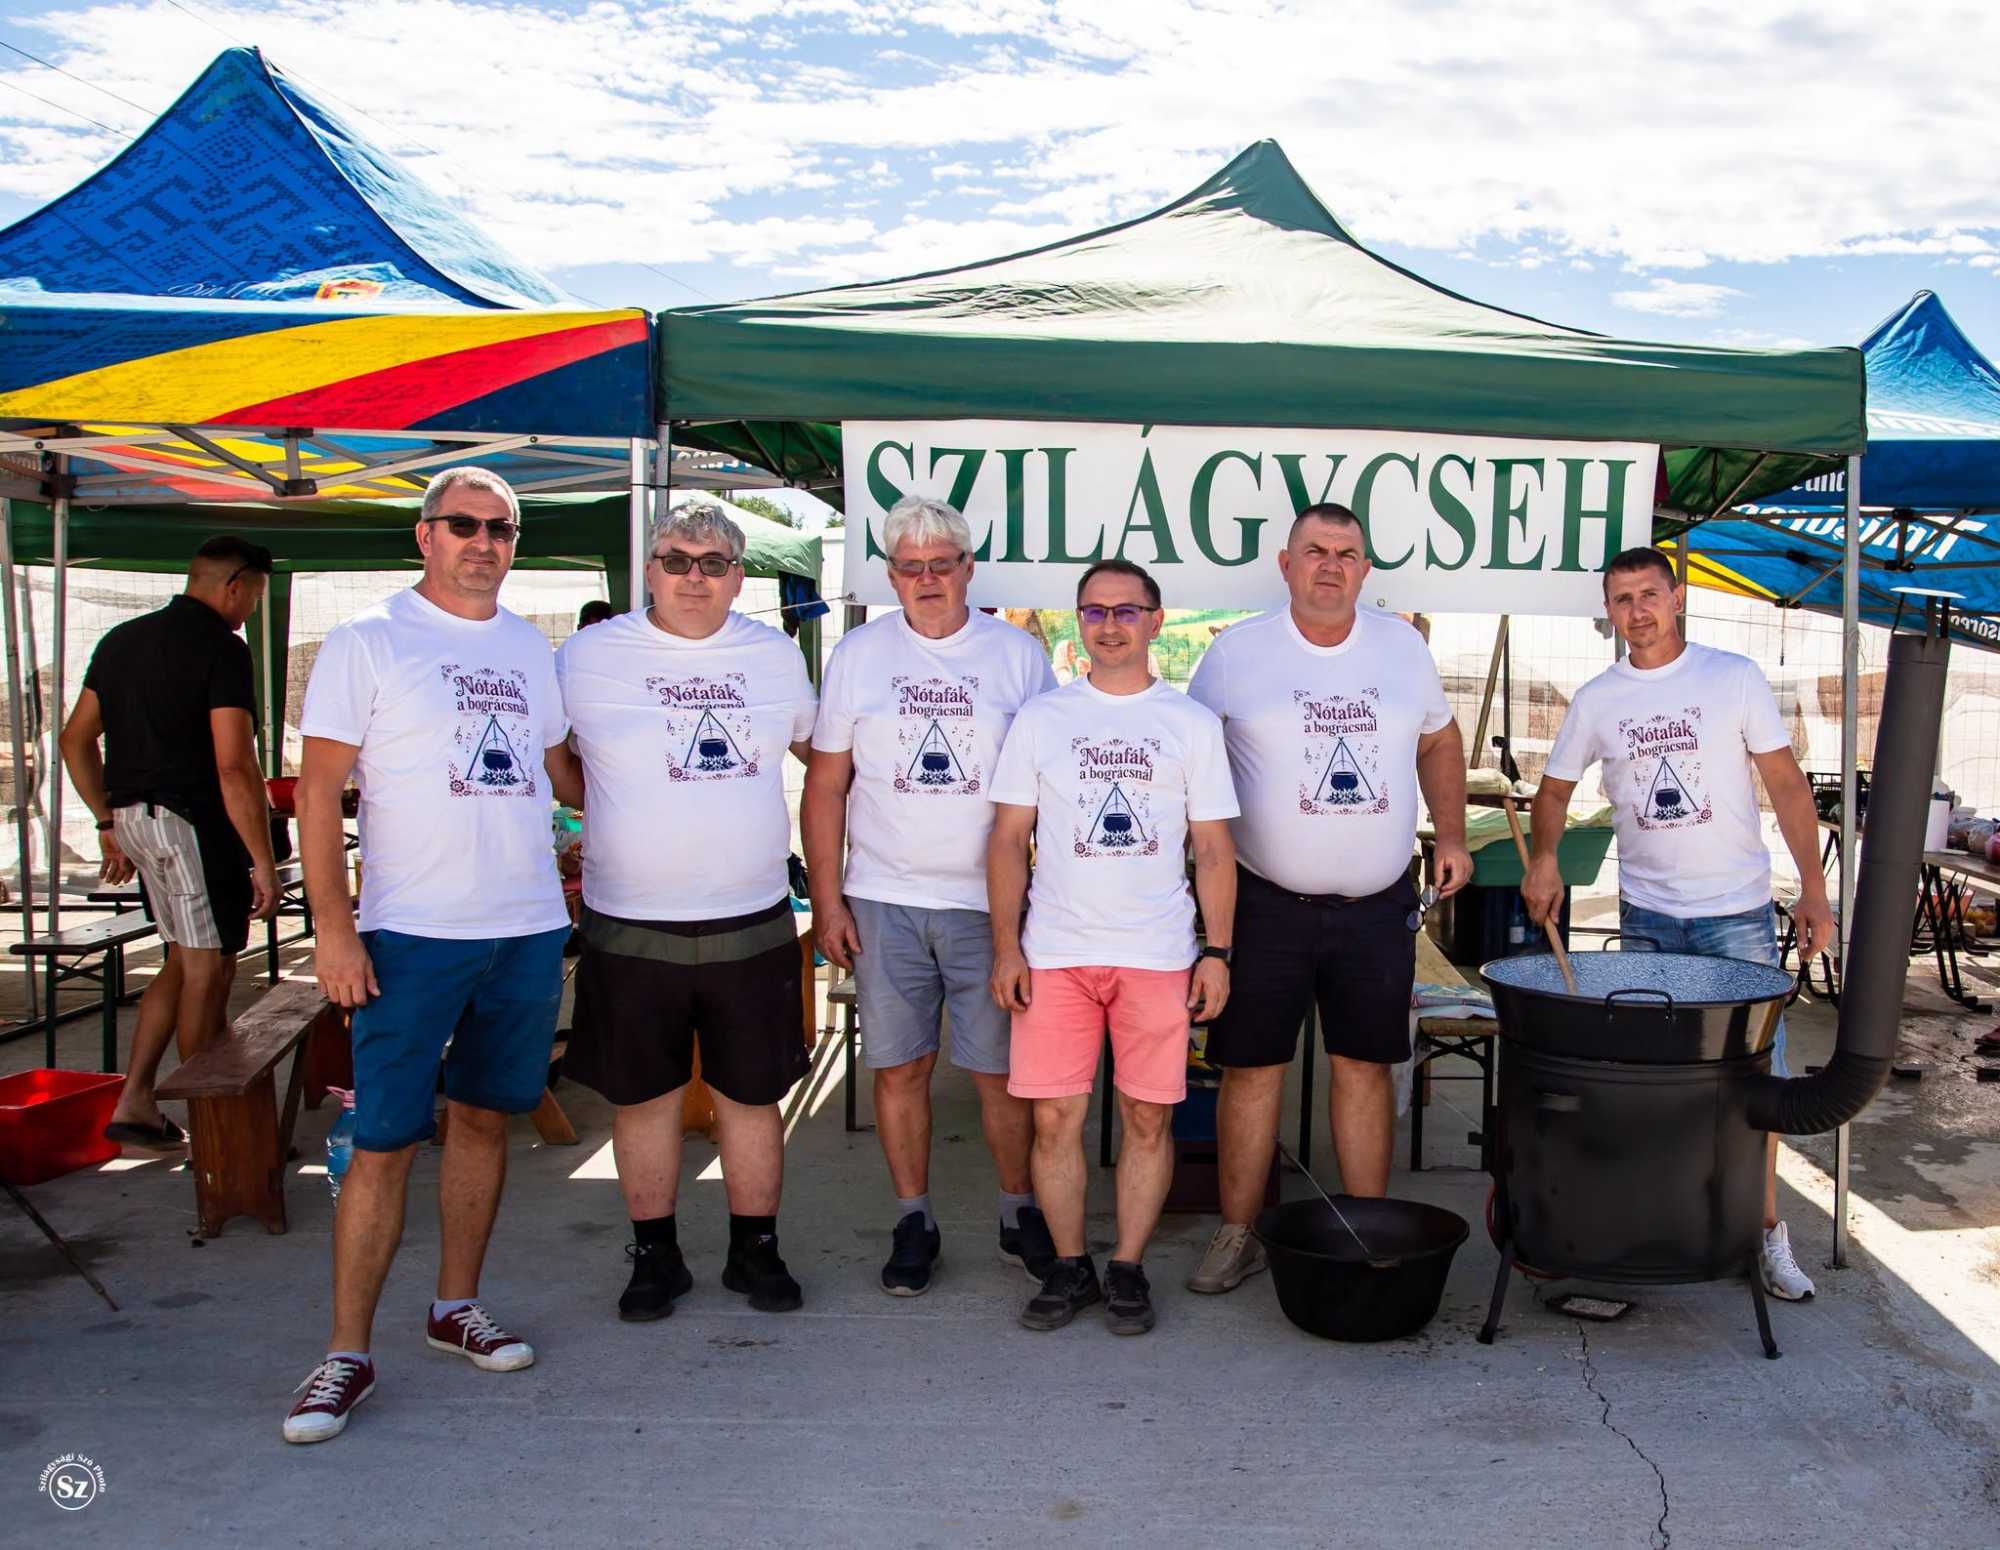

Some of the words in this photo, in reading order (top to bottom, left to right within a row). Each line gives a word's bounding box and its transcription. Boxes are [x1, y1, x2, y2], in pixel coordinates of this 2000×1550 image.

[866, 424, 1637, 573] SZILÁGYCSEH
[453, 675, 527, 702] Nótafák
[659, 683, 743, 705] Nótafák
[899, 685, 973, 704] Nótafák
[457, 700, 465, 711] a
[467, 697, 529, 716] bográcsnál
[899, 706, 906, 715] a
[909, 702, 974, 719] bográcsnál
[1303, 700, 1377, 720] Nótafák
[1304, 724, 1311, 733] a
[1313, 719, 1377, 737] bográcsnál
[1627, 720, 1697, 748] Nótafák
[1079, 746, 1154, 768] Nótafák
[1629, 751, 1636, 761] a
[1636, 739, 1698, 759] bográcsnál
[1079, 771, 1086, 780] a
[1089, 766, 1153, 782] bográcsnál
